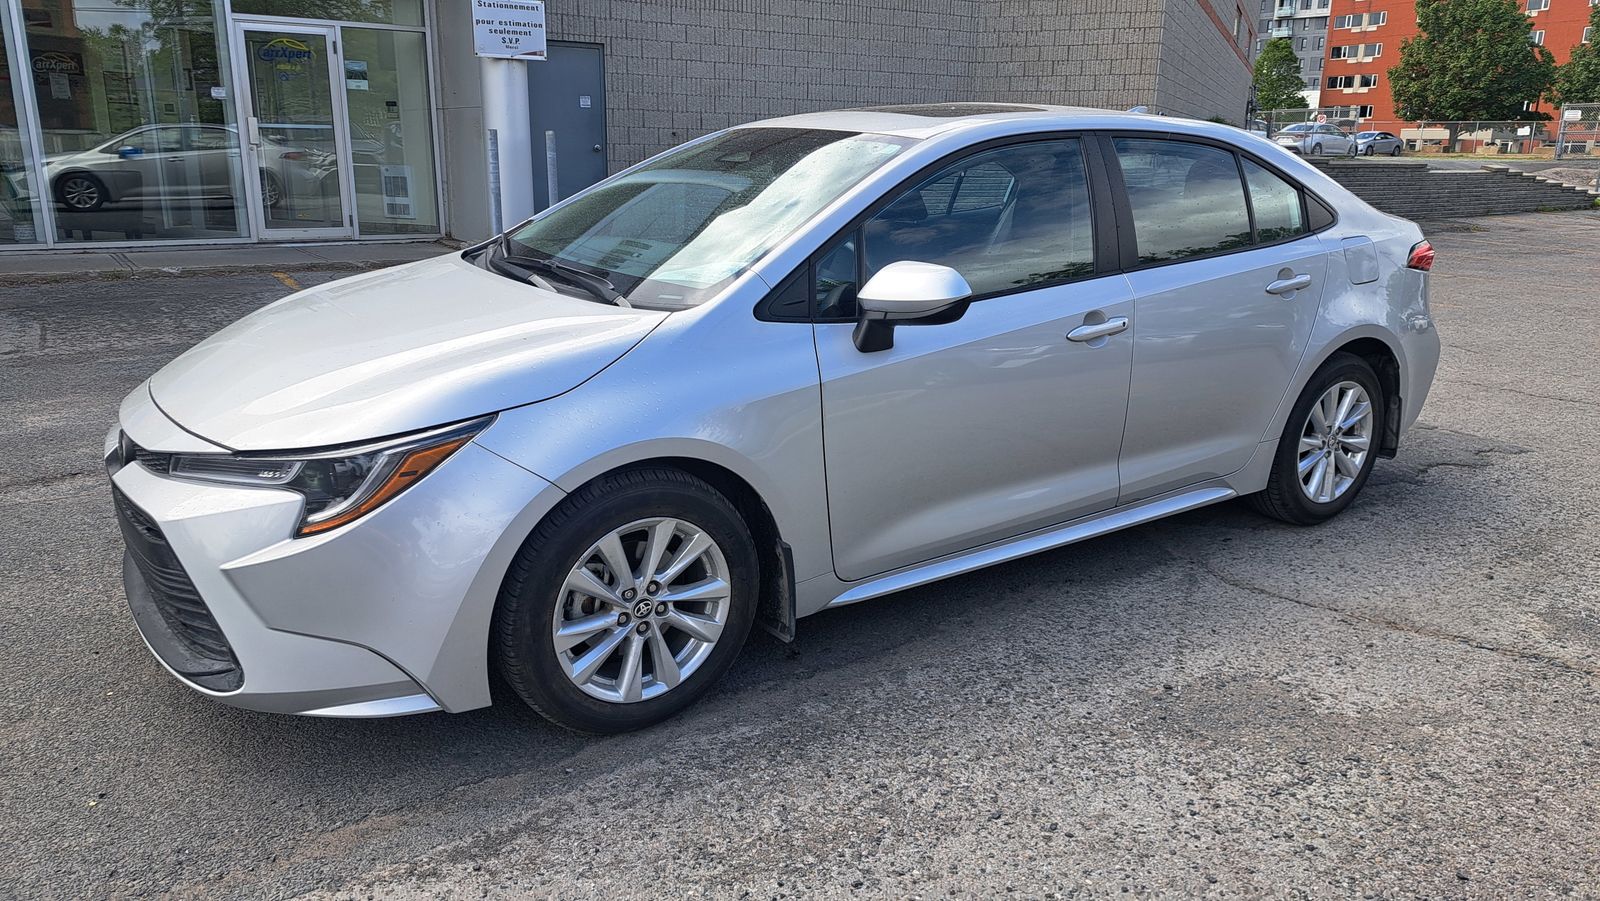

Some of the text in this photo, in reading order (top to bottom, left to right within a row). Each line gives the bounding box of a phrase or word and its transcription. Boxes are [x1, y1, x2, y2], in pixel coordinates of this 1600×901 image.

[477, 0, 539, 11] Stationnement
[475, 18, 543, 29] pour estimation
[488, 28, 532, 36] seulement
[501, 36, 520, 45] S.V.P.
